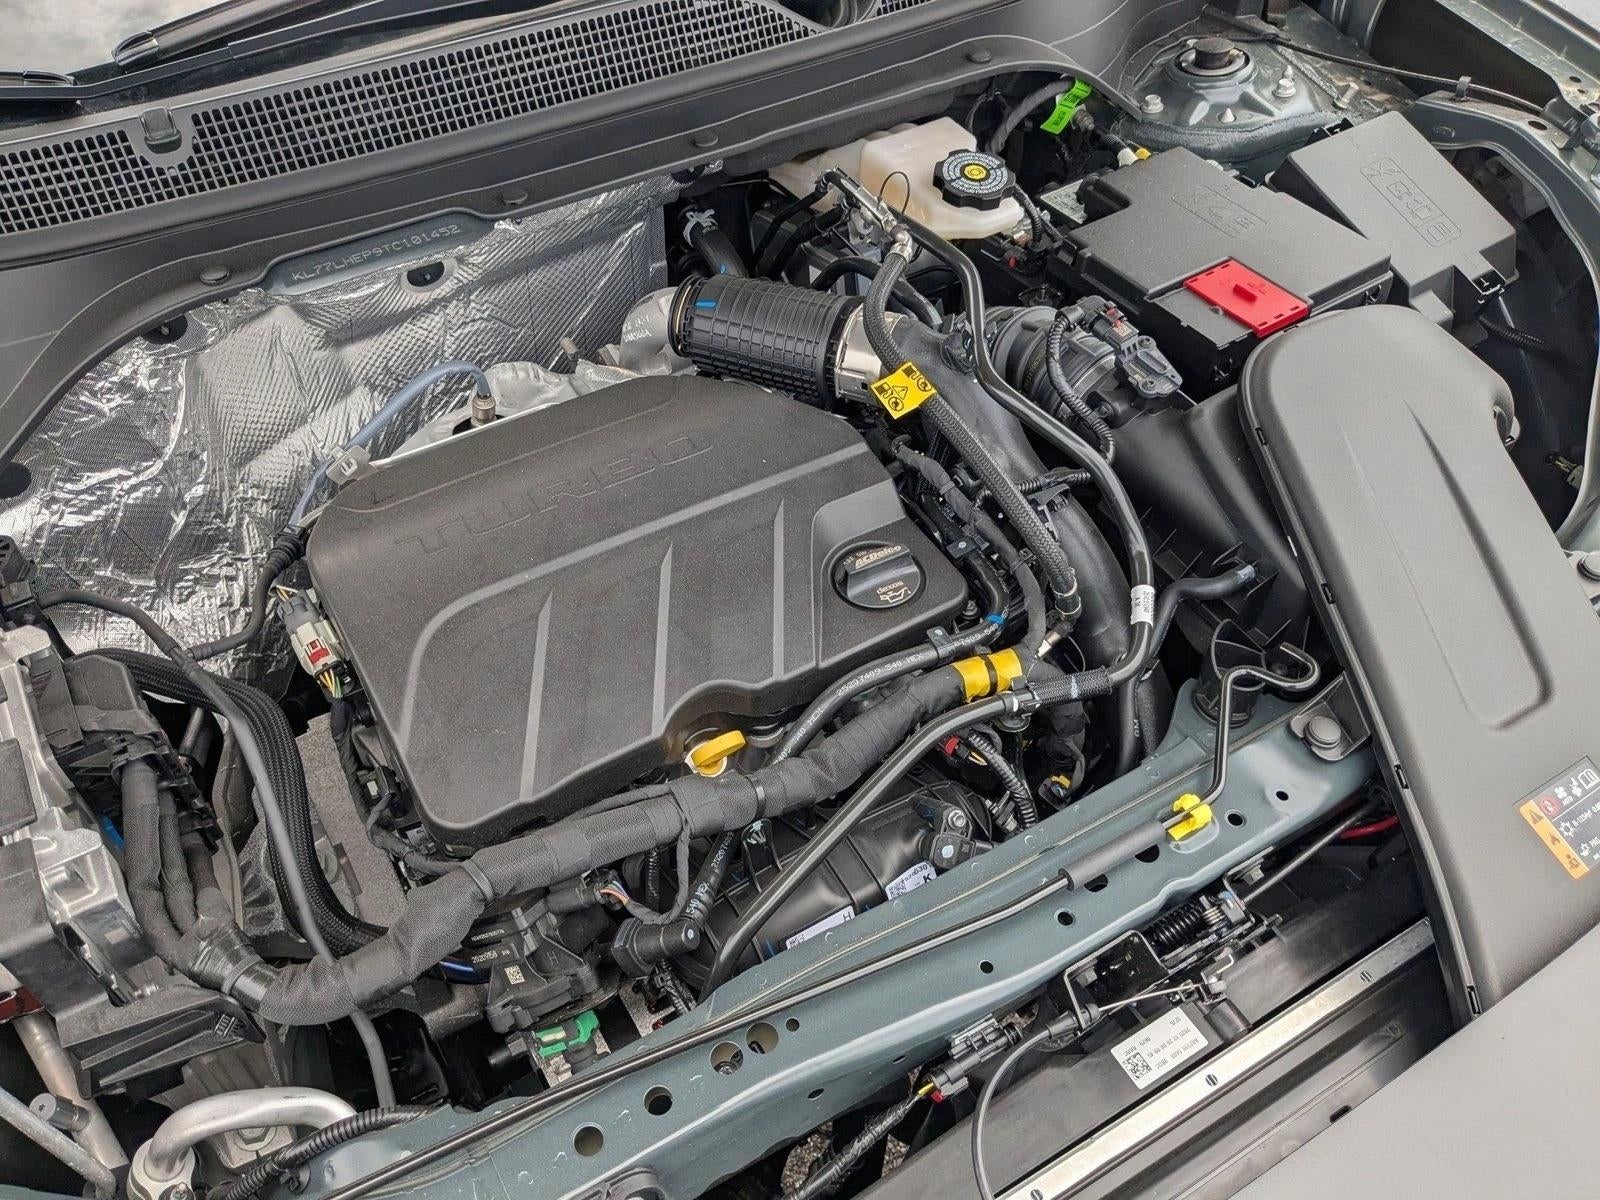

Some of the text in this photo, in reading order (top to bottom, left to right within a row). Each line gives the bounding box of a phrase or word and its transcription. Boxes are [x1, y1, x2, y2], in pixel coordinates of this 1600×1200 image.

[394, 435, 715, 556] TURBO
[855, 545, 902, 569] ACDelco
[876, 580, 904, 595] dexos
[836, 652, 924, 697] 25207409 540 MEX
[807, 706, 825, 726] MEX
[922, 872, 932, 884] K
[695, 881, 710, 896] MEX
